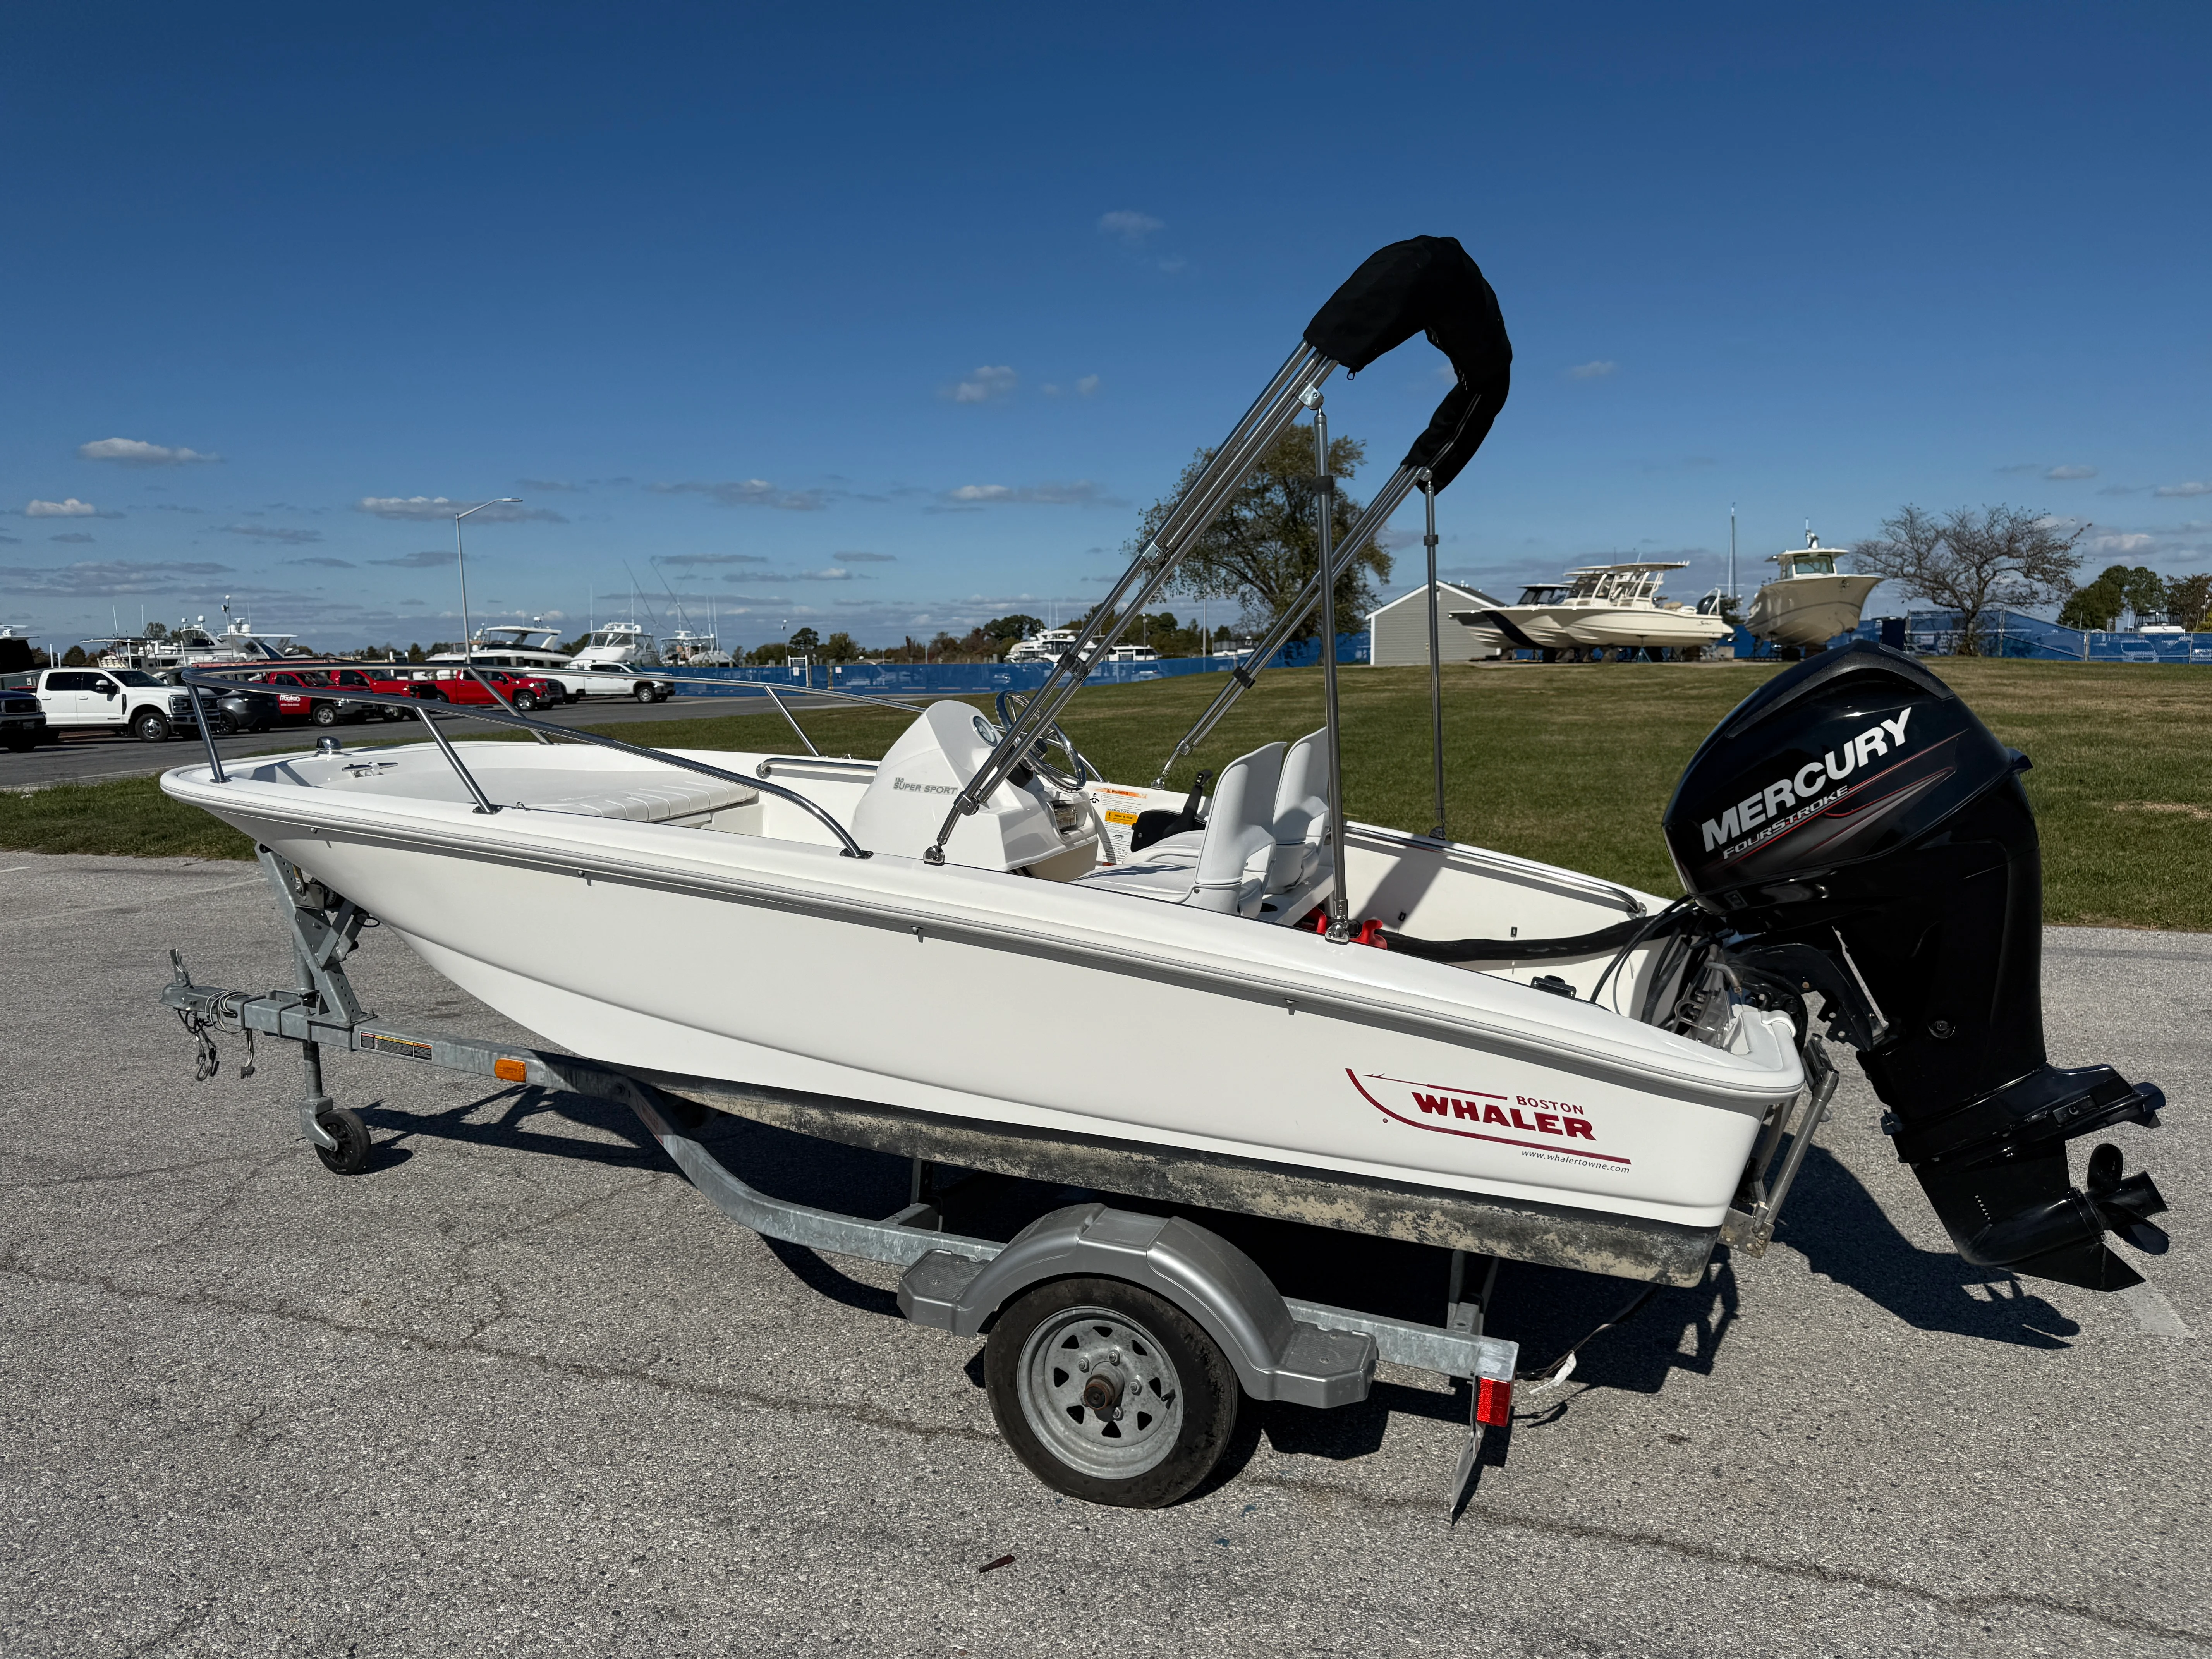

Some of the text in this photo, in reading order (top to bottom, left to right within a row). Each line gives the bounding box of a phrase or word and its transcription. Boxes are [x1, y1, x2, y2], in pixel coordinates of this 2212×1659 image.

[893, 782, 958, 794] SUPER SPORT
[1702, 706, 1911, 852] MERCURY
[1723, 785, 1848, 859] FOURSTROKE
[1412, 1092, 1597, 1141] WHALER
[1516, 1096, 1584, 1115] BOSTON
[1522, 1150, 1630, 1173] www.whalertowne.com
